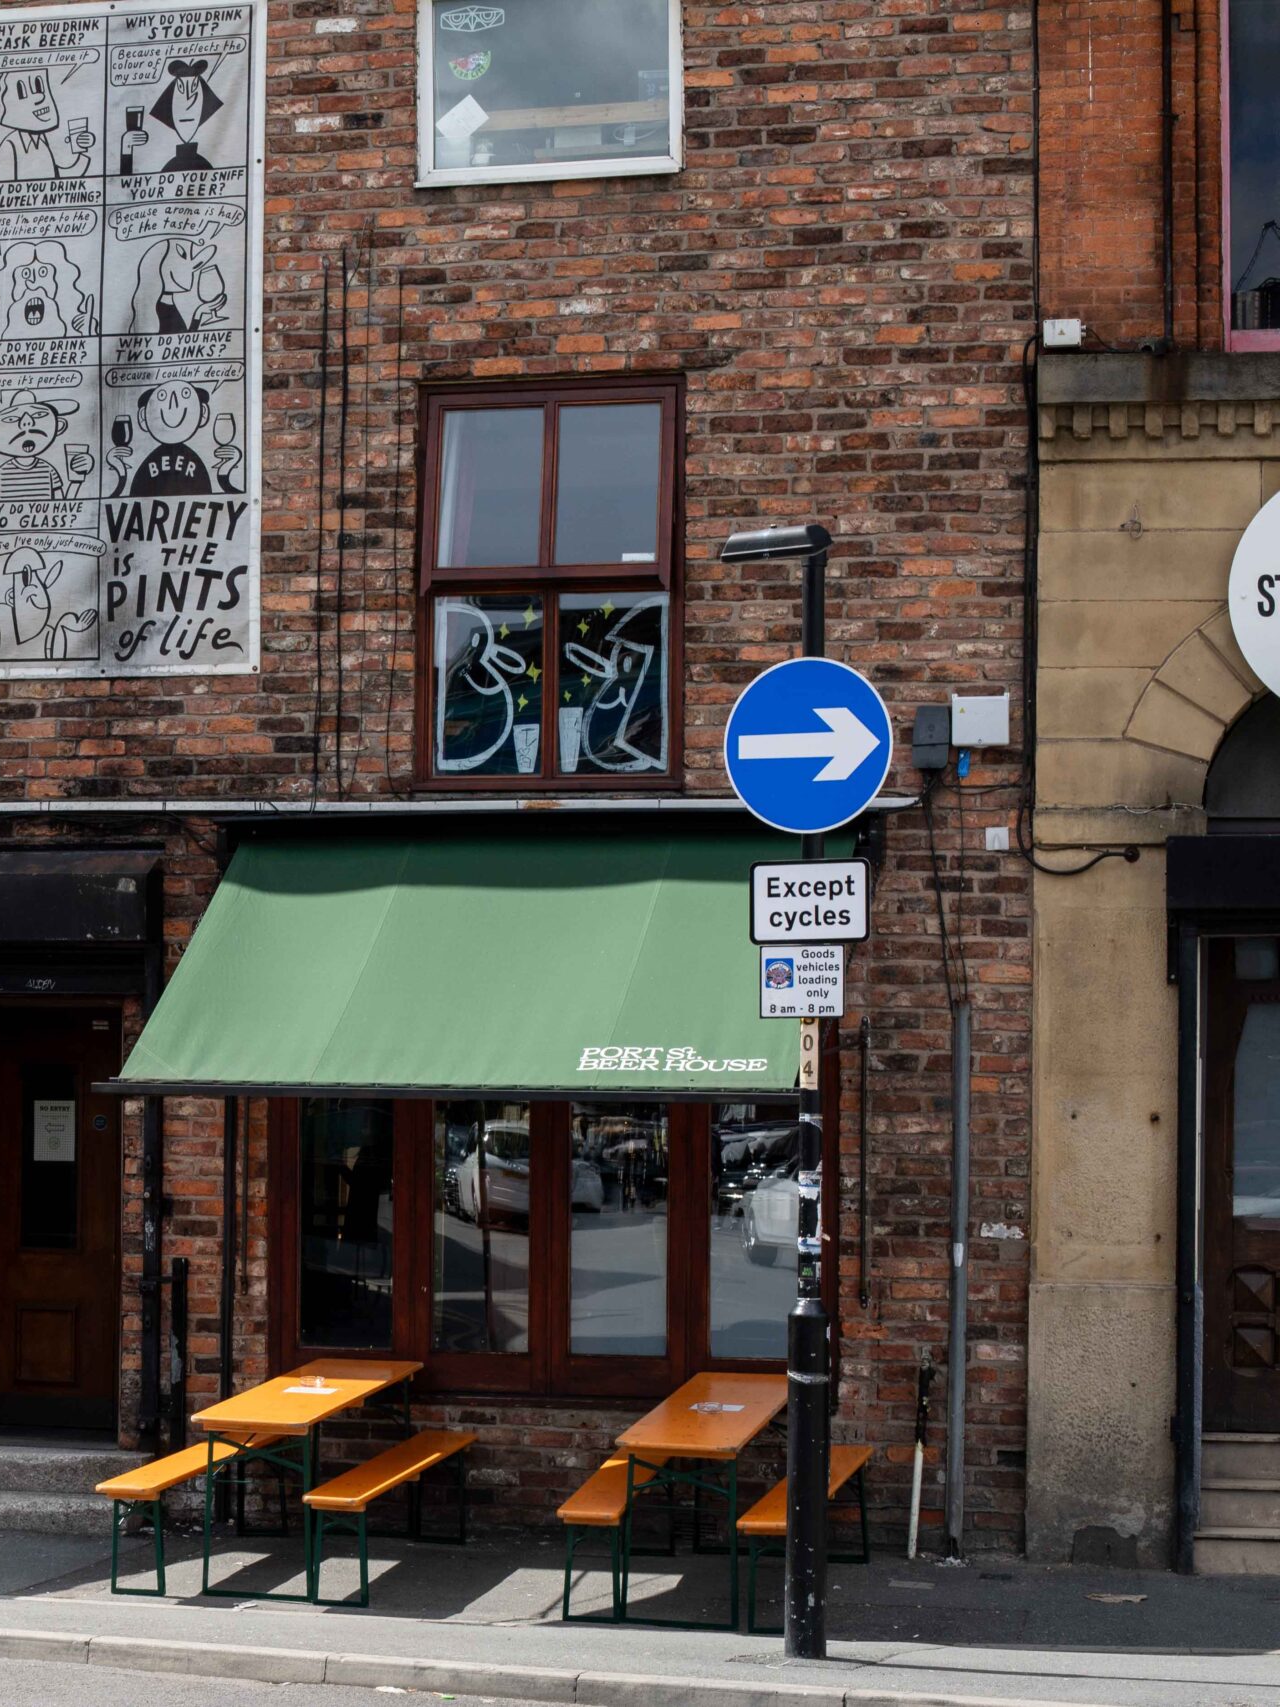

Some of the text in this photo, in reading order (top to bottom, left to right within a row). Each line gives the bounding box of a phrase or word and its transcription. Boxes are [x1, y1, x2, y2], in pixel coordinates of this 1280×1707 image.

[22, 23, 37, 34] DO
[40, 22, 60, 33] YOU
[63, 20, 99, 32] DRINK
[126, 9, 242, 29] WHY DO YOU DRINK
[148, 22, 219, 40] STOUT?
[39, 33, 85, 47] BEER?
[118, 40, 241, 60] Because it reflects the
[1, 50, 89, 68] Because I love it
[112, 58, 161, 70] colour of
[114, 68, 157, 85] my soul
[8, 184, 22, 194] DO
[26, 182, 46, 193] YOU
[50, 180, 86, 191] DRINK
[120, 169, 244, 189] WHY DO YOU SNIFF
[41, 191, 102, 206] ANYTHING?
[130, 182, 226, 200] YOUR BEER?
[15, 214, 29, 225] I'm
[33, 215, 56, 226] open
[59, 211, 69, 221] to
[73, 211, 90, 221] the
[115, 205, 242, 225] Because aroma is half
[40, 225, 50, 237] of
[54, 223, 87, 234] NOW!
[122, 217, 203, 238] of the taste!
[6, 342, 21, 353] DO
[25, 341, 46, 352] YOU
[49, 340, 86, 351] DRINK
[119, 331, 232, 348] WHY DO YOU HAVE
[0, 353, 36, 366] SAME
[40, 351, 88, 366] BEER?
[115, 344, 227, 362] TWO DRINKS?
[17, 375, 33, 386] it's
[37, 373, 77, 388] perfect
[111, 364, 243, 385] Because I couldn't decide!
[148, 455, 197, 479] BEER
[9, 503, 23, 515] DO
[28, 502, 50, 514] YOU
[52, 502, 83, 513] HAVE
[19, 514, 77, 529] GLASS?
[104, 499, 249, 544] VARIETY
[13, 535, 32, 548] I've
[34, 536, 53, 550] only
[53, 536, 74, 550] just
[73, 541, 103, 554] arrived
[160, 542, 219, 567] THE
[106, 565, 249, 622] PINTS
[1257, 574, 1280, 618] S
[114, 614, 244, 662] of life
[767, 875, 855, 900] Except
[769, 905, 851, 931] cycles
[801, 949, 835, 959] Goods
[796, 962, 840, 972] vehicles
[798, 975, 838, 986] loading
[806, 988, 830, 999] only
[769, 1004, 776, 1014] 8
[780, 1006, 796, 1014] am
[808, 1004, 815, 1014] 8
[818, 1005, 835, 1015] pm
[580, 1046, 702, 1060] PORT St.
[576, 1058, 768, 1072] BEER HOUSE
